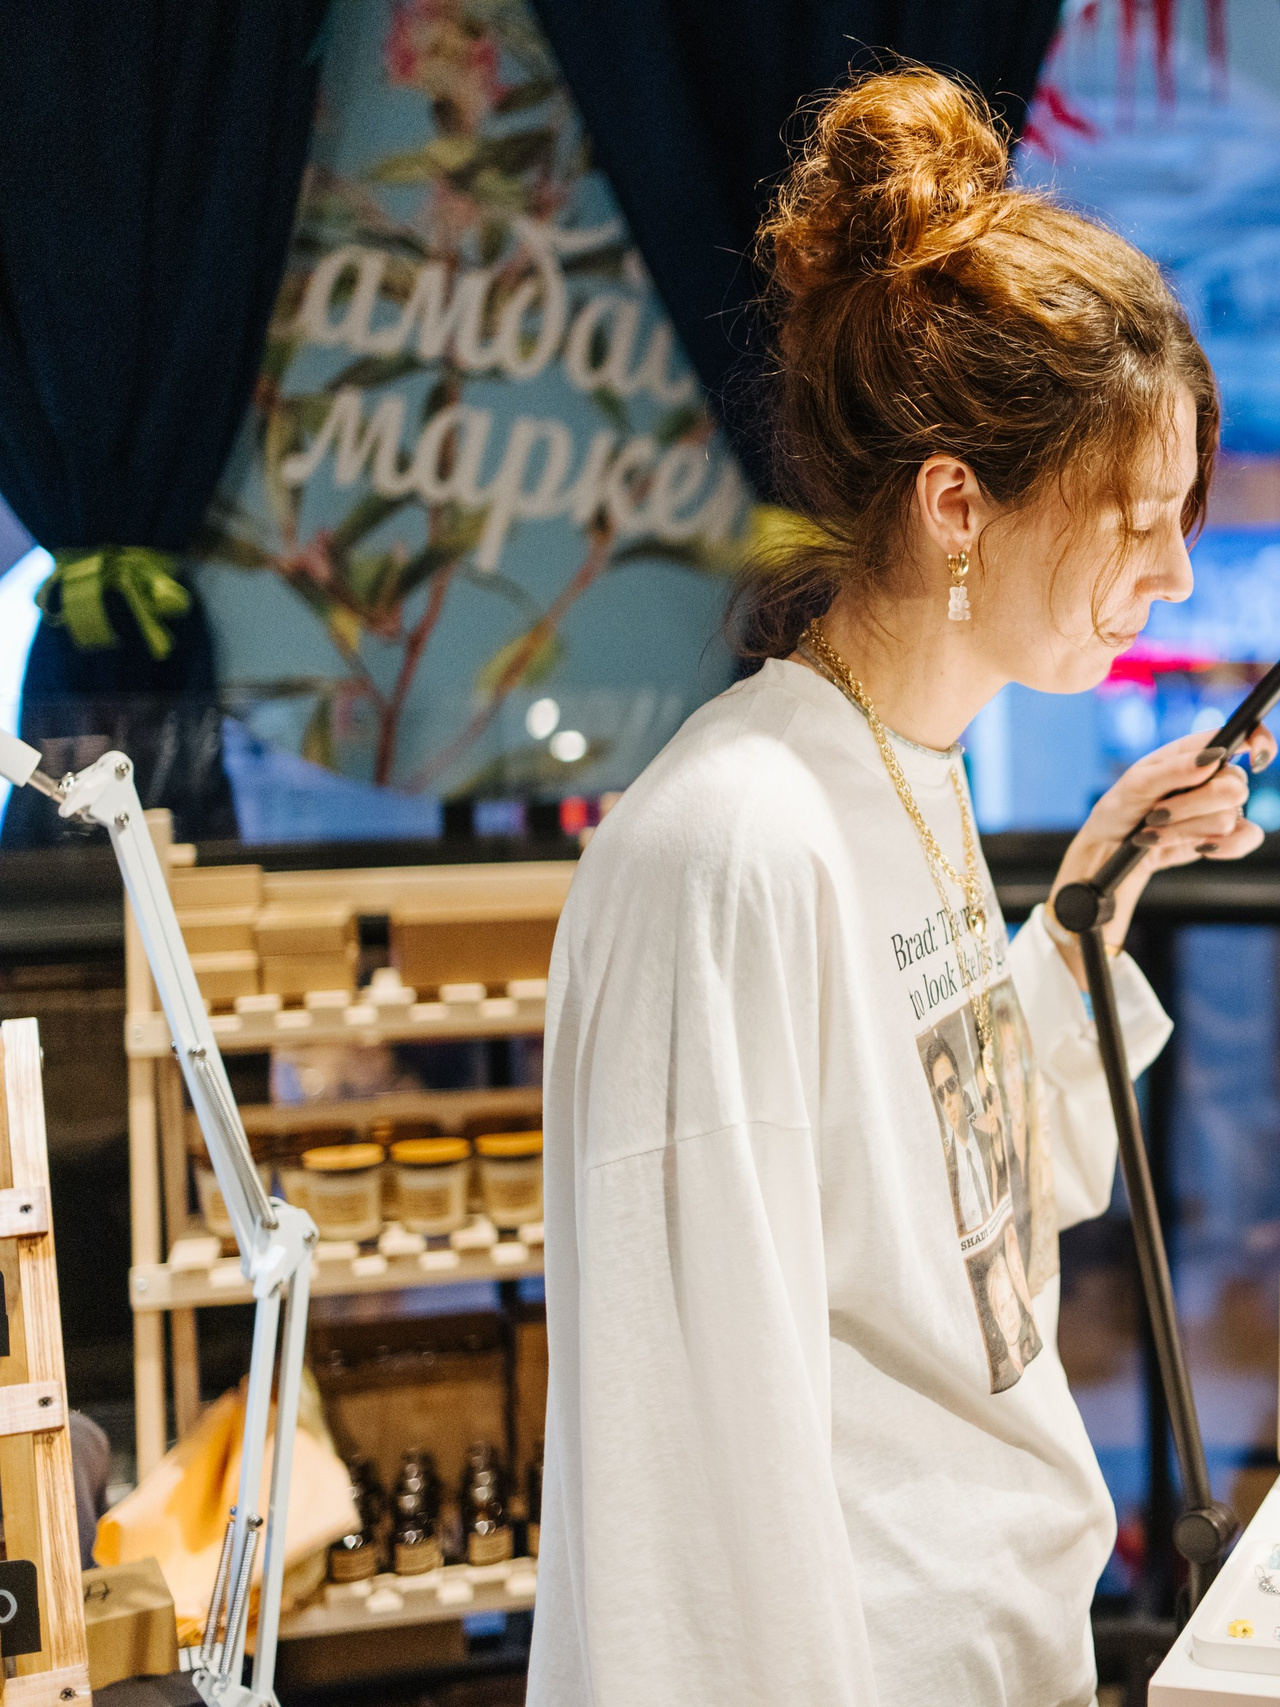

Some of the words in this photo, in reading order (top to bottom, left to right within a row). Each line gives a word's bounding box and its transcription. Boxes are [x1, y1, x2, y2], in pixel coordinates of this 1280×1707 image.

[890, 916, 939, 971] Brad:
[908, 988, 926, 1021] to
[922, 961, 958, 1010] look
